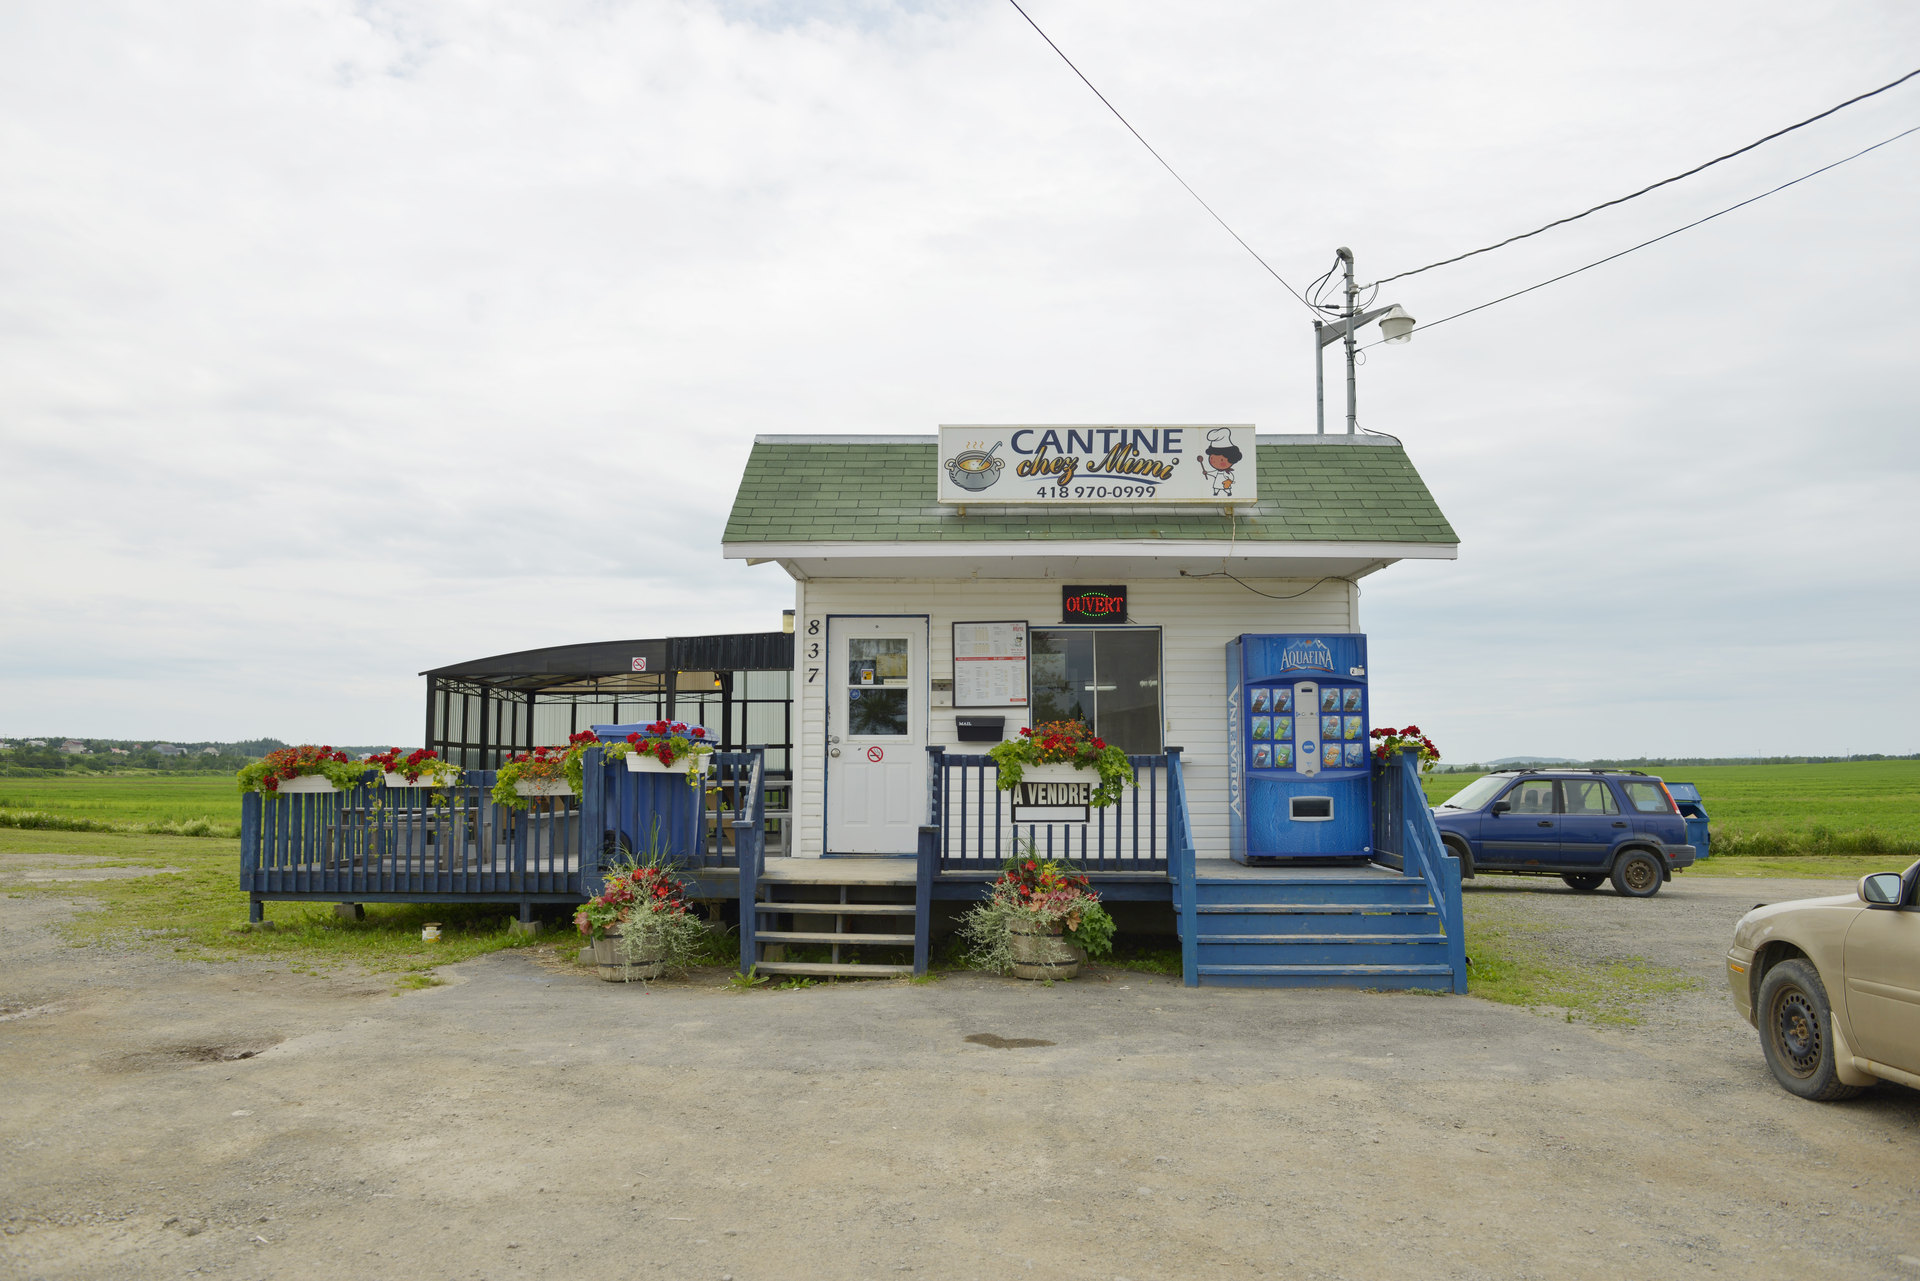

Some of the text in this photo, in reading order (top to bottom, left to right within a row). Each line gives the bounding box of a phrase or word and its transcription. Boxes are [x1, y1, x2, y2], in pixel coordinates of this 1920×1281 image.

[1010, 428, 1183, 455] CANTINE
[1016, 442, 1179, 486] chez Mimi
[1037, 486, 1156, 498] 418 970-0999
[1066, 596, 1124, 613] OUVERT
[1280, 647, 1335, 671] AQUAFINA
[1228, 683, 1242, 817] AQUAFINA
[1027, 783, 1089, 805] VENDRE
